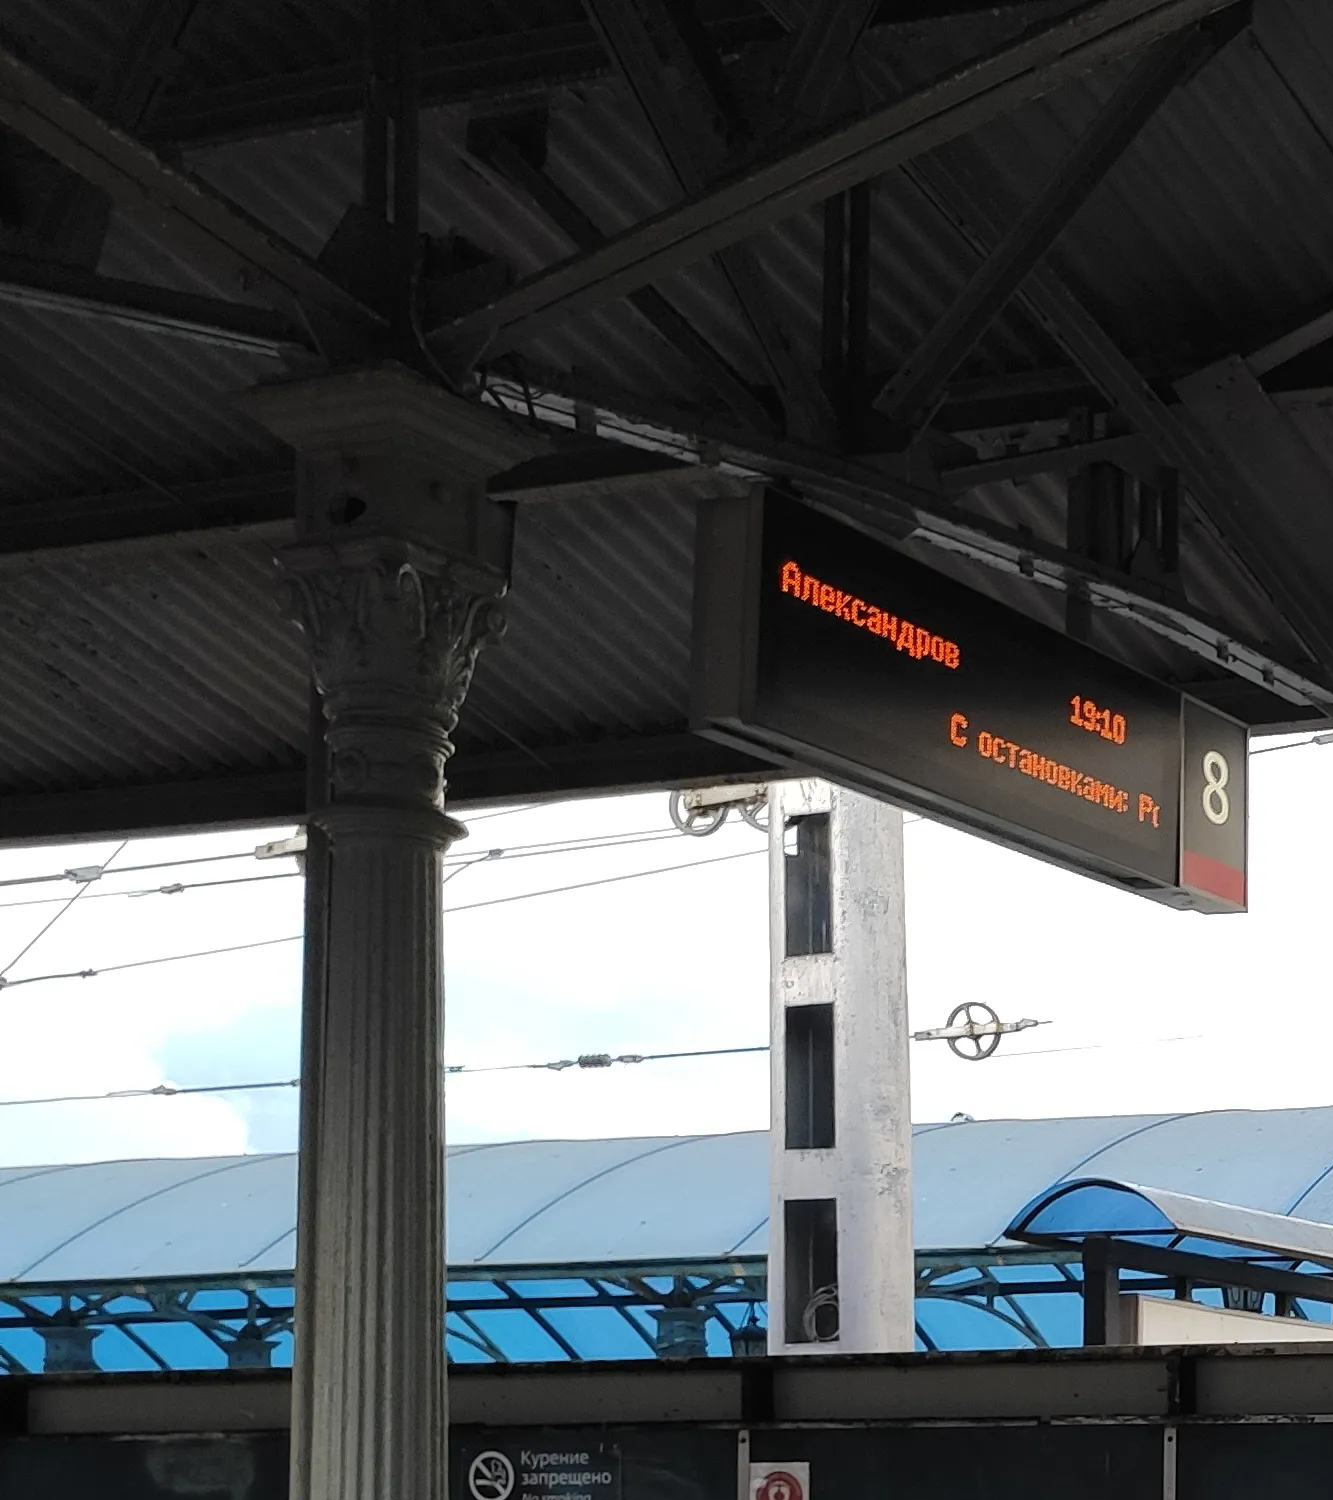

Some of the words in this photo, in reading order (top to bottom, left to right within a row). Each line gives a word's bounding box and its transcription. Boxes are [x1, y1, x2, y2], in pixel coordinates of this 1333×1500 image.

[779, 560, 960, 670] Александров
[1070, 696, 1128, 746] 19:10
[949, 713, 969, 748] С
[977, 731, 1129, 814] остановками:
[1202, 750, 1229, 825] 8
[520, 1450, 589, 1467] Курение
[520, 1471, 612, 1487] запрещено
